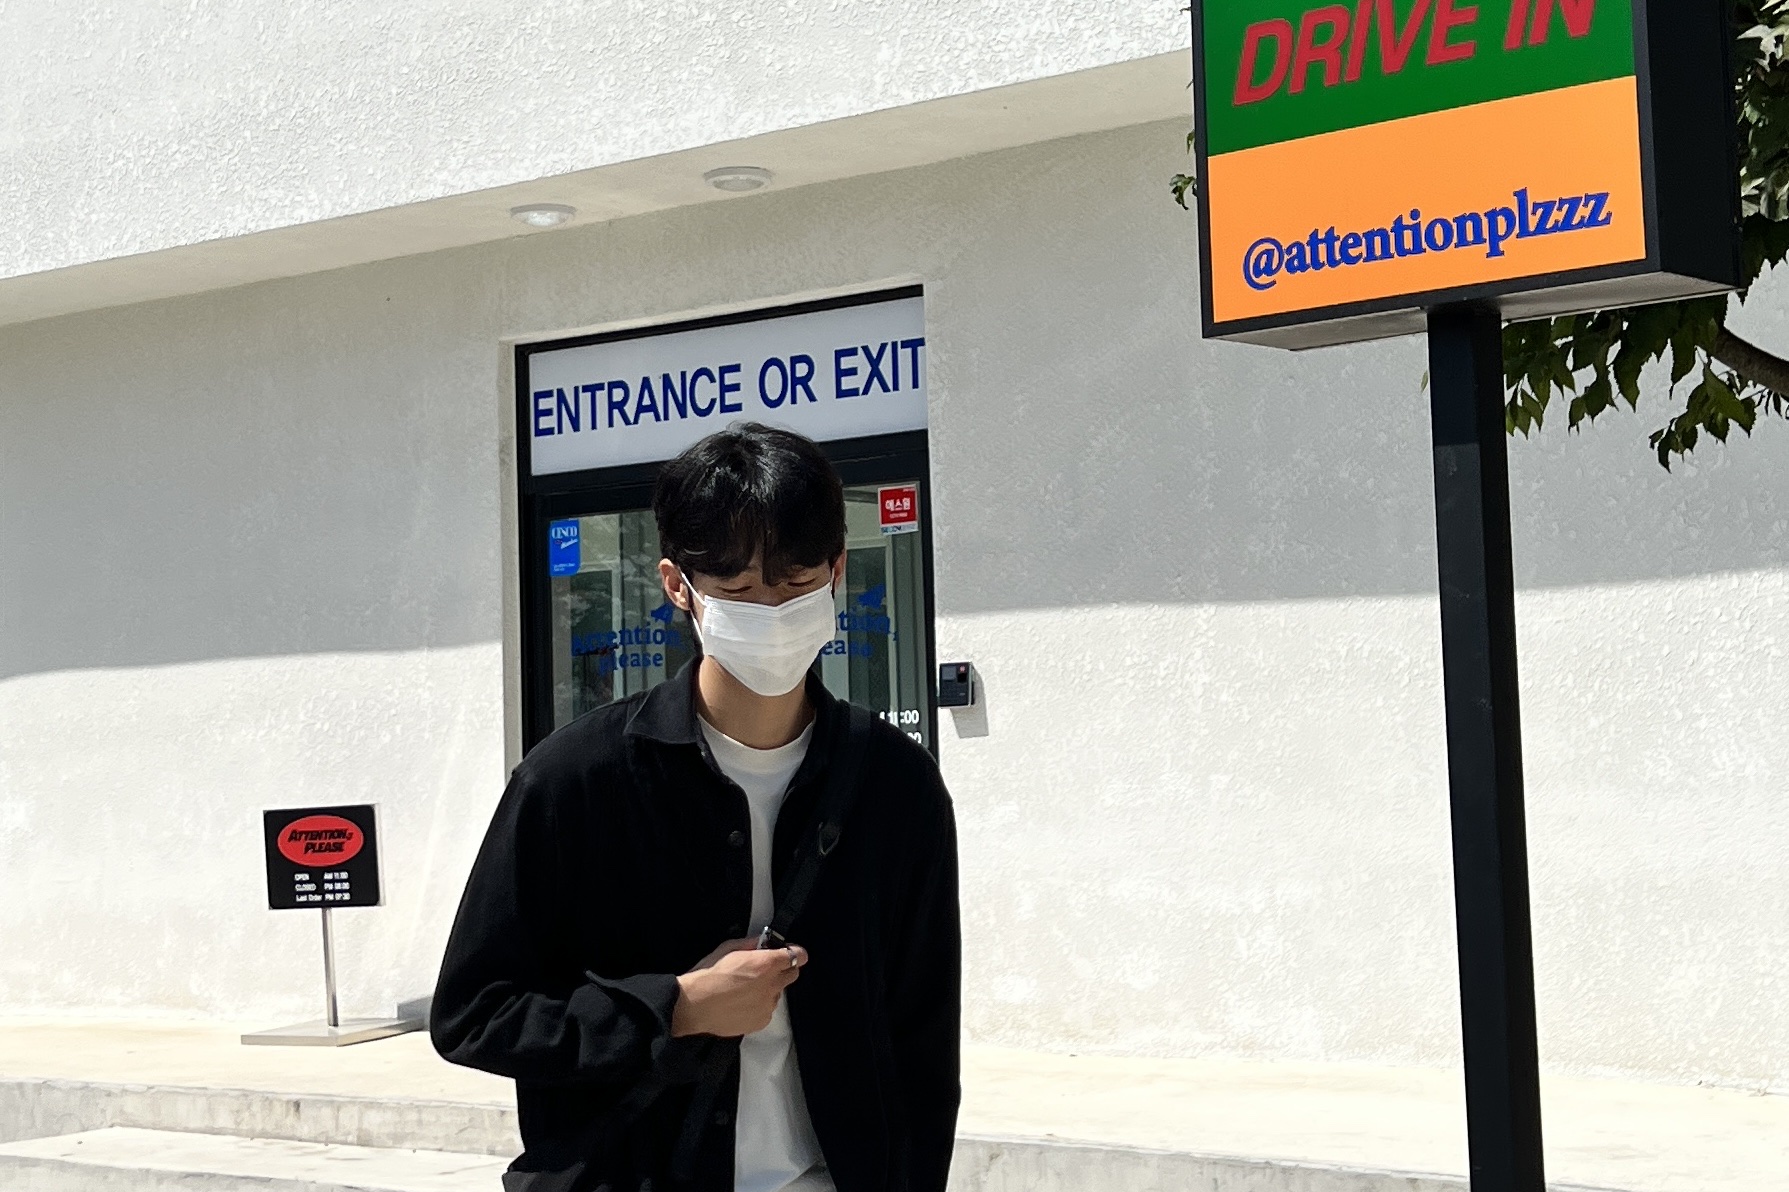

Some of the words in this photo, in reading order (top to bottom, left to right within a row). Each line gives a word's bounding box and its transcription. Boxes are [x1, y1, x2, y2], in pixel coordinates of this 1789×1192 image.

[1233, 0, 1478, 106] DRIVE
[1504, 0, 1595, 50] IN
[1243, 187, 1612, 290] @attentionplzzz
[533, 363, 743, 437] ENTRANCE
[758, 354, 818, 408] OR
[834, 337, 925, 399] EXIT
[304, 842, 345, 854] PLEASE
